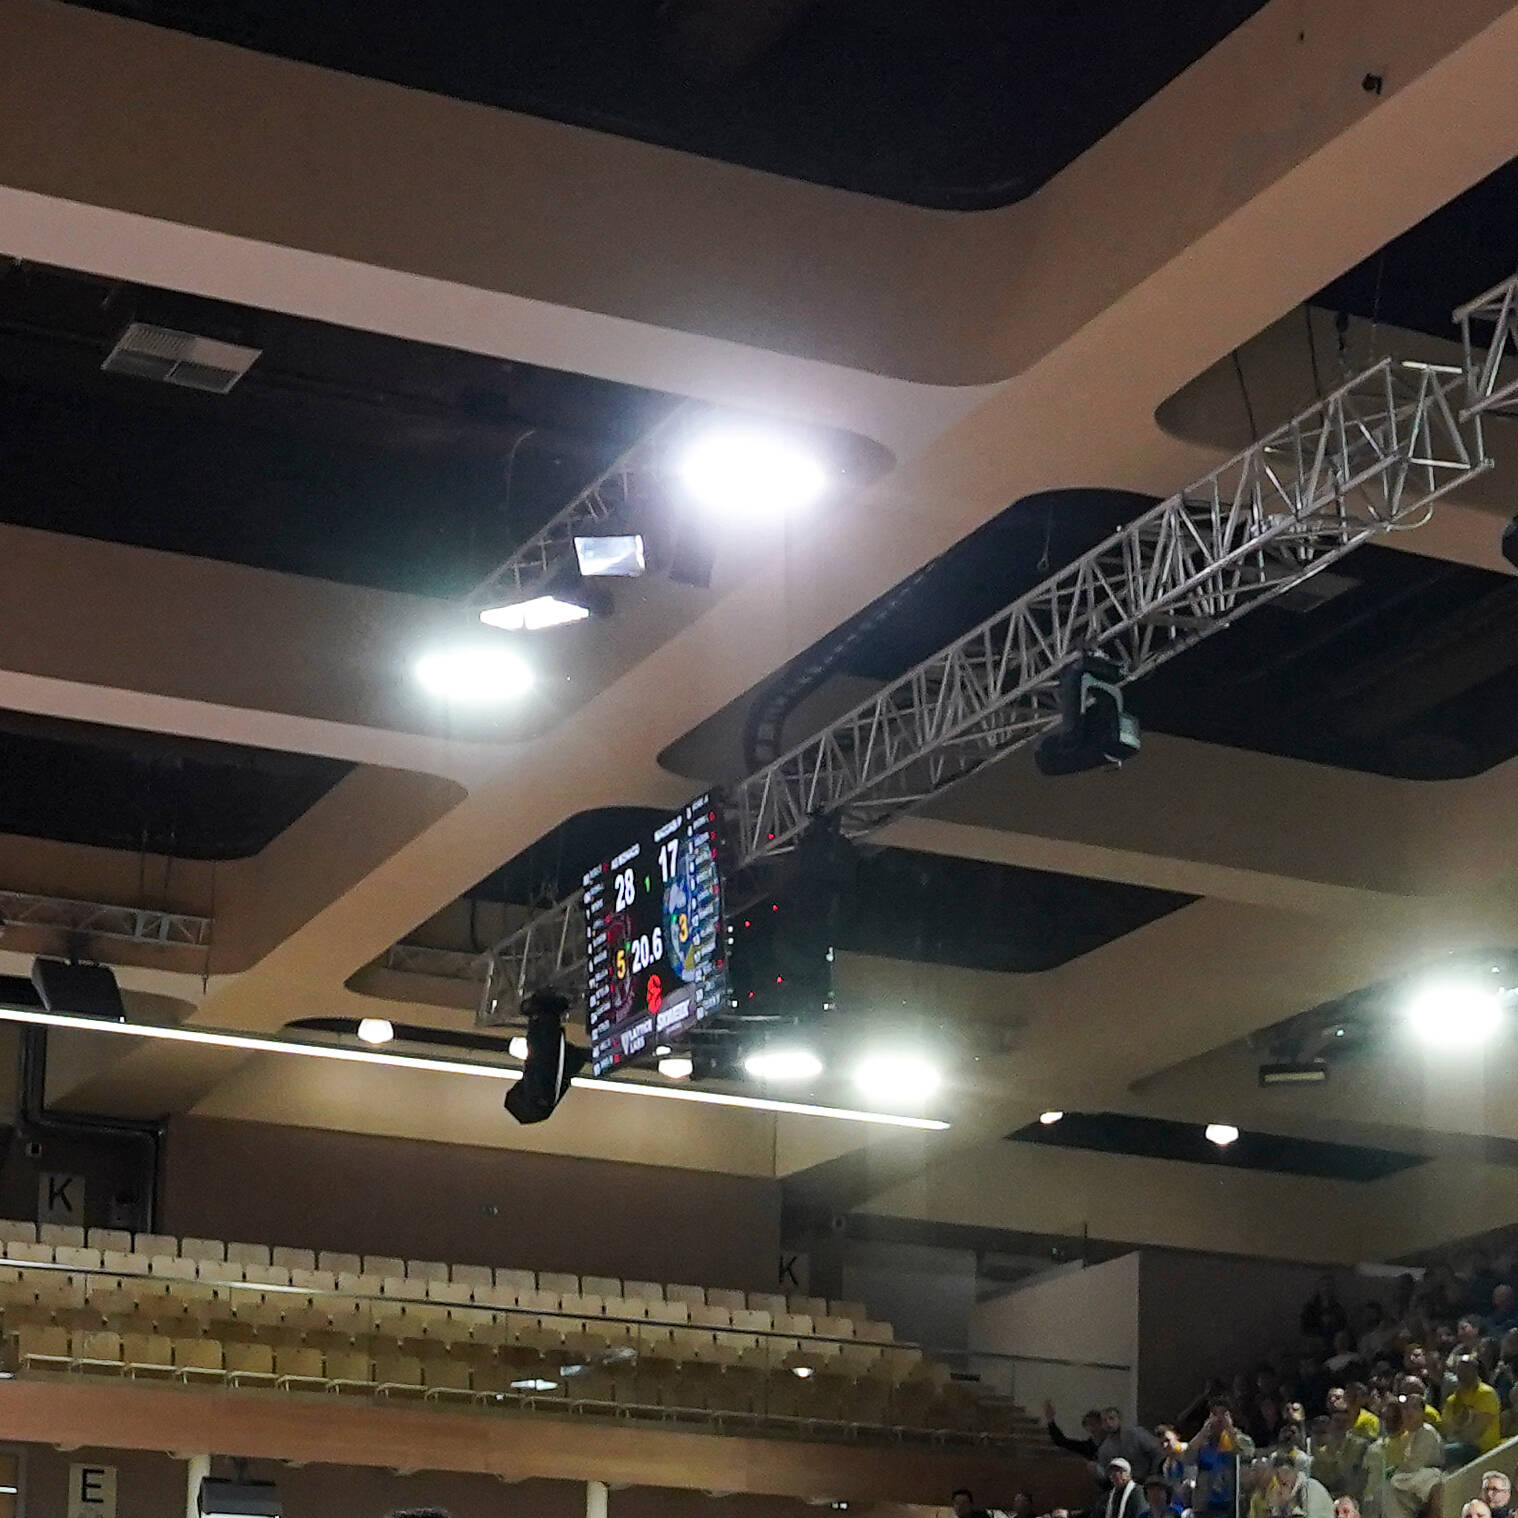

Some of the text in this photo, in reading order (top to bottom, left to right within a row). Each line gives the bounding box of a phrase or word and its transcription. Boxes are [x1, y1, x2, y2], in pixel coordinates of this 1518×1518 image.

[658, 838, 679, 882] 17
[614, 868, 636, 913] 28
[616, 949, 627, 979] 5
[631, 926, 663, 974] 20.6
[48, 1177, 73, 1212] K
[779, 1255, 799, 1286] K
[81, 1468, 105, 1503] E
